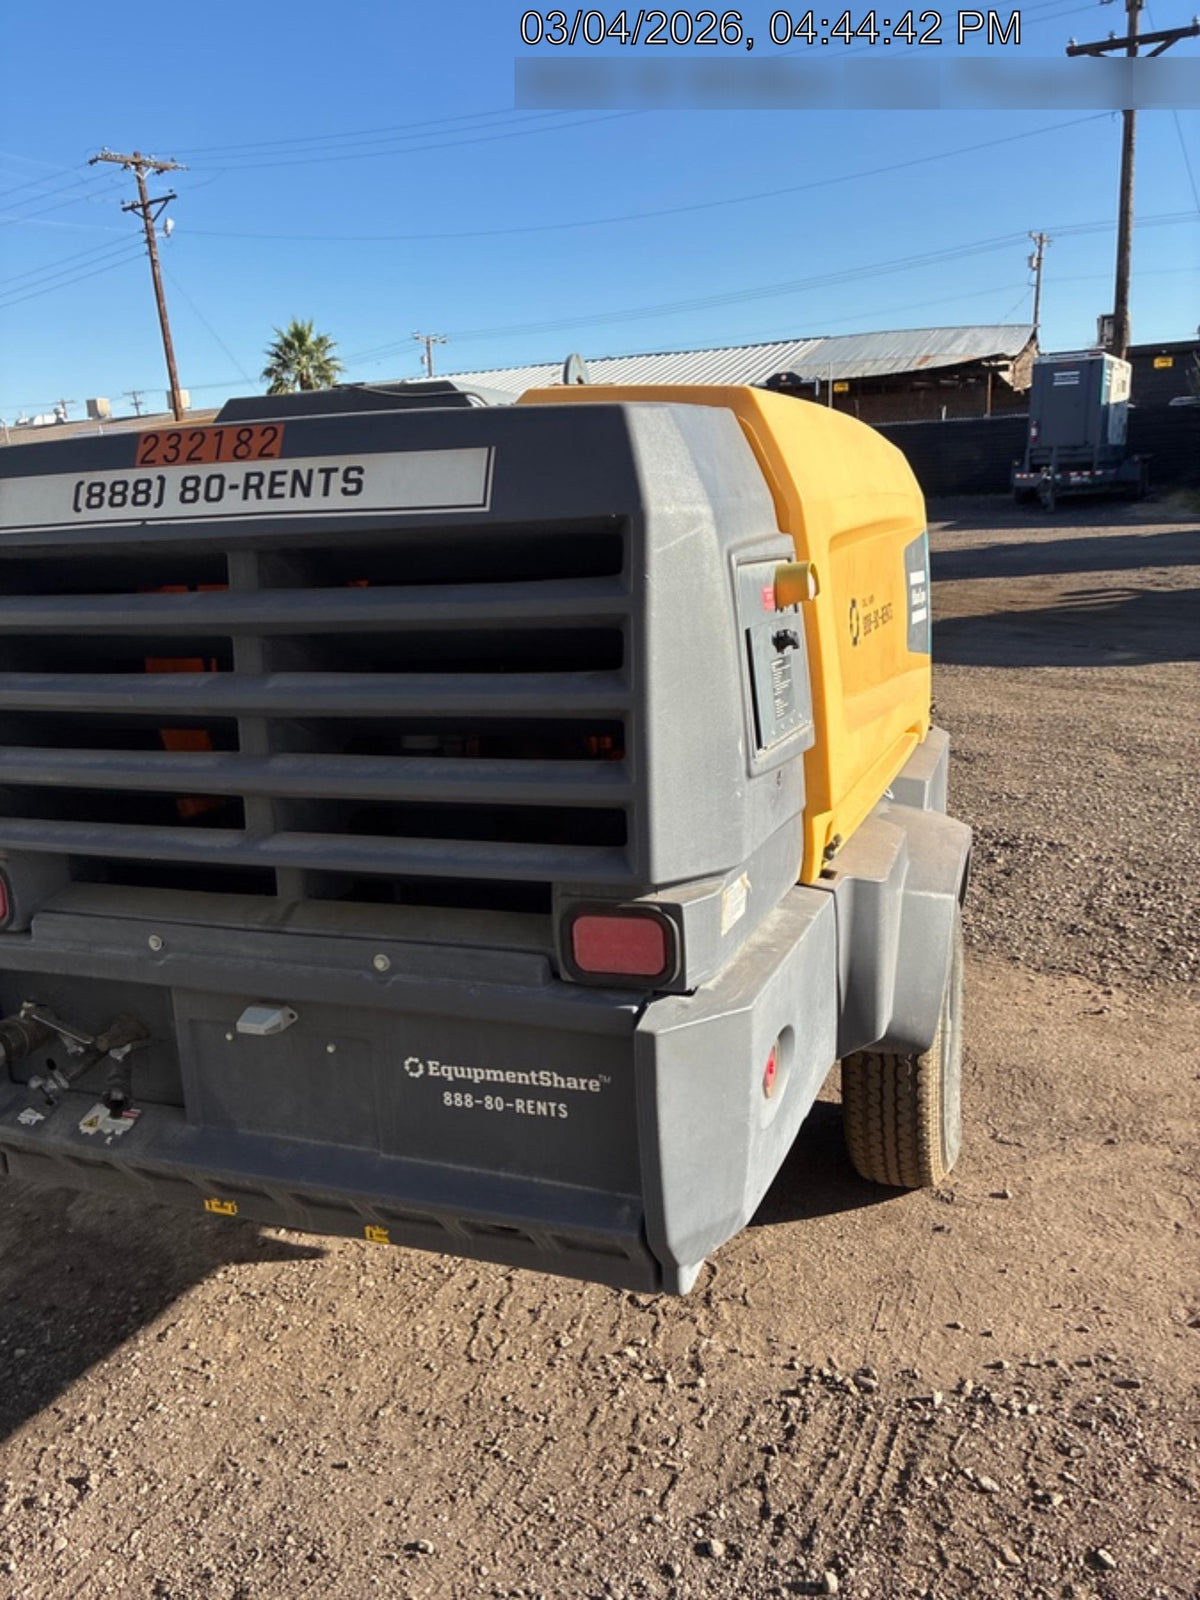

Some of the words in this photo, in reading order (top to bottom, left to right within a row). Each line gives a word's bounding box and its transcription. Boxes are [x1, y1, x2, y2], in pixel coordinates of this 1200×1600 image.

[139, 426, 279, 465] 232182
[73, 476, 166, 513] (888)
[179, 465, 365, 503] 80-RENTS
[427, 1060, 600, 1092] EquipmentShare
[443, 1091, 568, 1118] 888-80-RENTS
